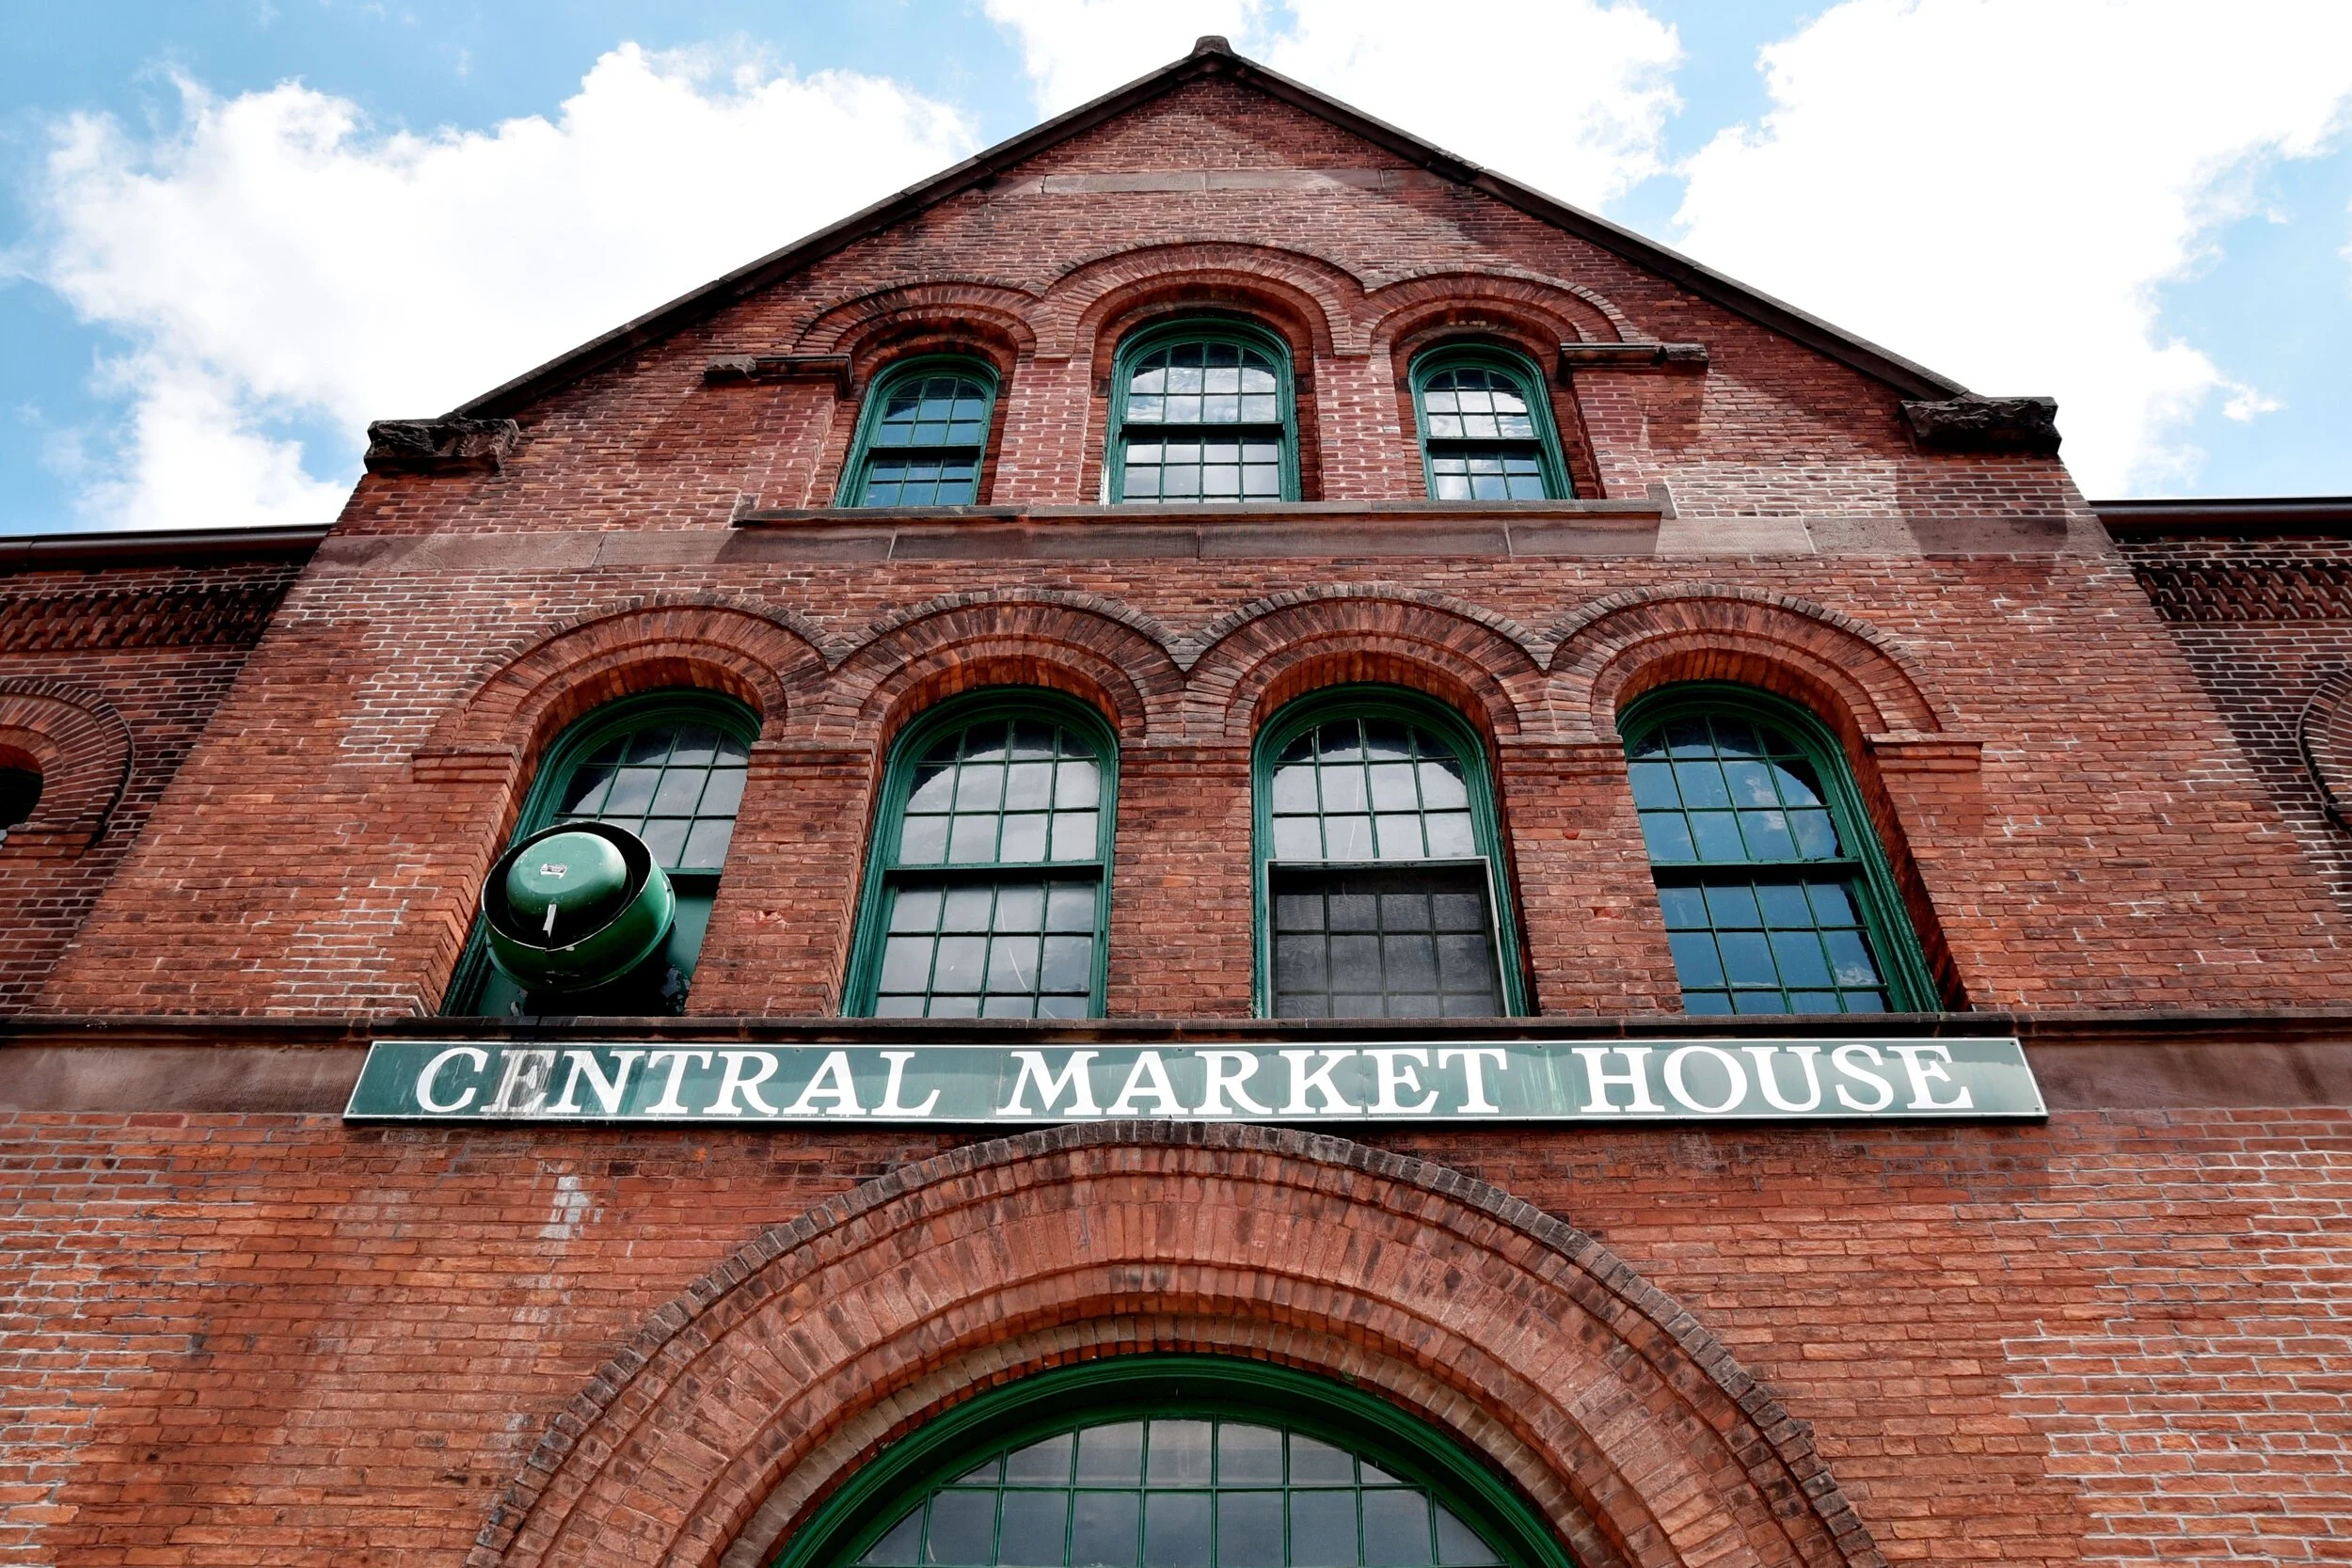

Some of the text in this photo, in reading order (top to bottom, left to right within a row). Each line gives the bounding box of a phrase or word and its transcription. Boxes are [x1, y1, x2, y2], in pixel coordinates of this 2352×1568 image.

[416, 1044, 1974, 1116] CENTRAL MARKET HOUSE
